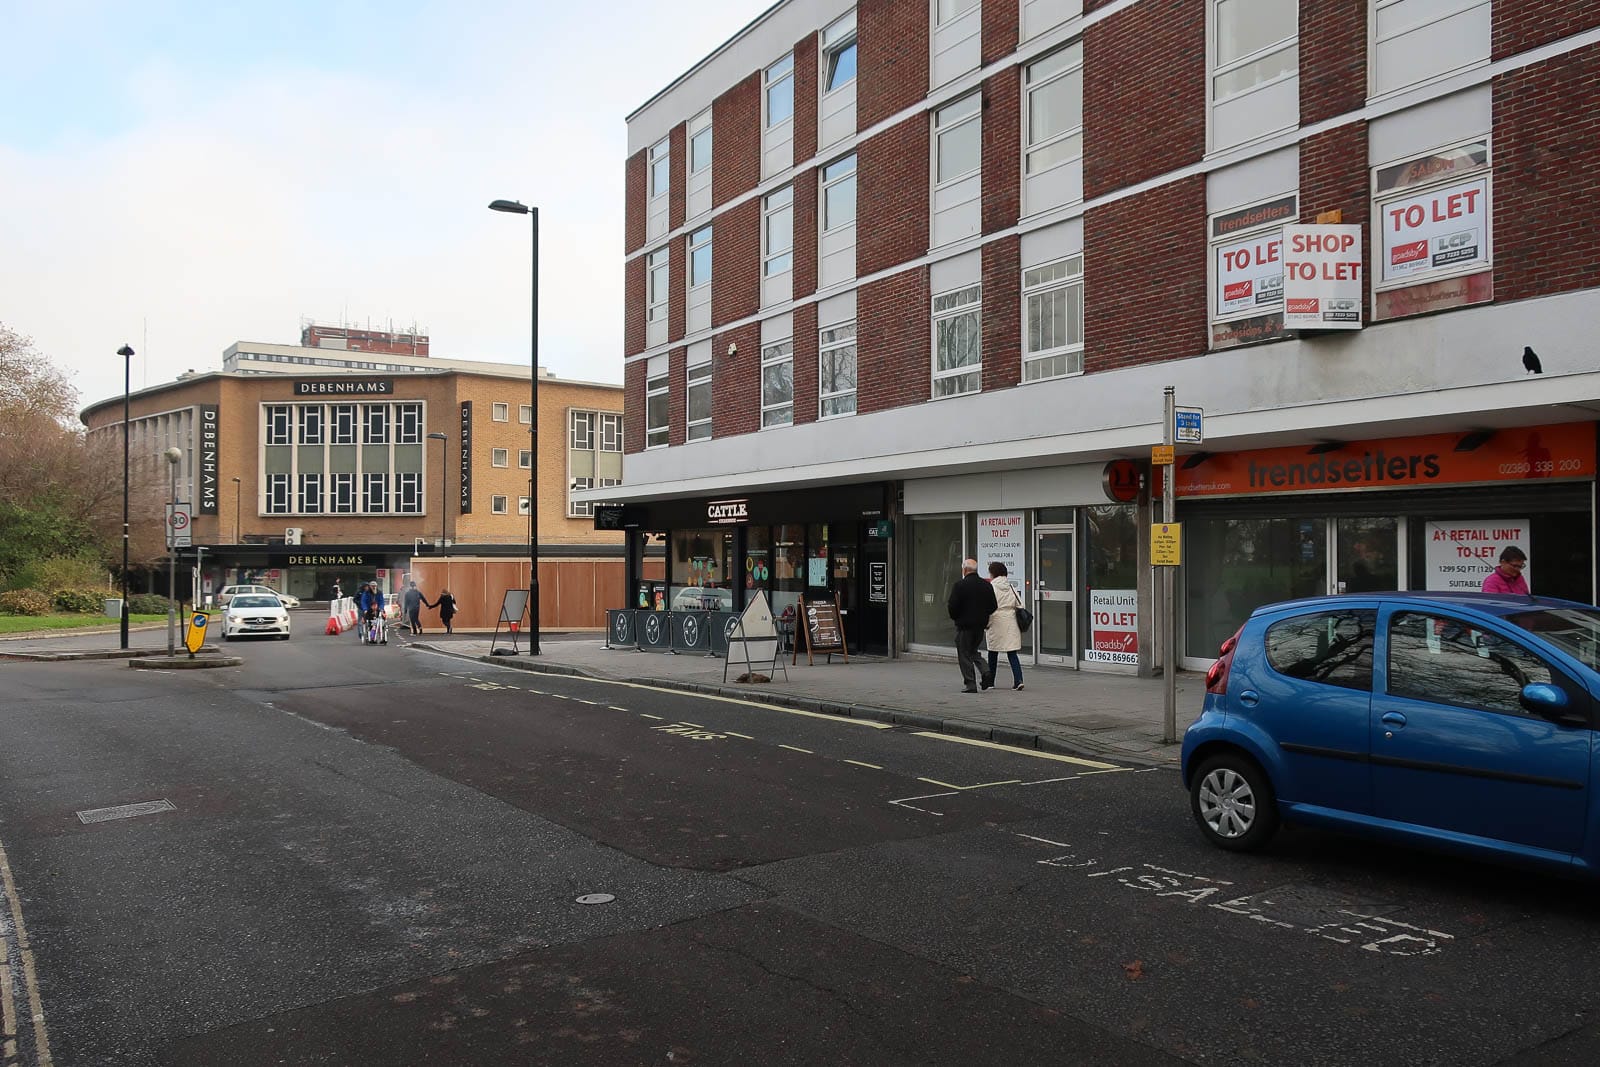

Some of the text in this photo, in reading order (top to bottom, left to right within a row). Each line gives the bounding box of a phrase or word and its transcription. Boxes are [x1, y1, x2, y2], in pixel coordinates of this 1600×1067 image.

[1410, 159, 1455, 178] SALON
[1389, 189, 1481, 232] TO LET
[1291, 234, 1355, 253] SHOP
[1438, 232, 1473, 250] LCP
[1223, 239, 1283, 272] TO LE
[1285, 262, 1361, 281] TO LET
[1287, 302, 1311, 312] goadsby
[301, 382, 386, 393] DEBENHAMS
[204, 411, 216, 508] DEBENHAMS
[1499, 461, 1531, 474] 02380
[1559, 458, 1581, 471] 200
[1248, 451, 1441, 488] trendsetters
[707, 503, 748, 518] CATTLE
[981, 516, 1021, 526] A1 RETAIL UNIT
[991, 529, 1010, 538] TO LET
[1433, 528, 1521, 541] A1 RETAIL UNIT
[1456, 546, 1496, 558] TO LET
[288, 556, 364, 565] DEBENHAMS
[1439, 565, 1494, 574] 1299 SQ FT (120
[1449, 580, 1482, 588] SUITABLE
[1093, 595, 1135, 606] Retail Unit
[1093, 611, 1137, 626] TO LET
[1095, 639, 1127, 653] goadsby
[1088, 651, 1111, 661] 01962
[1036, 854, 1443, 957] DISABLED
